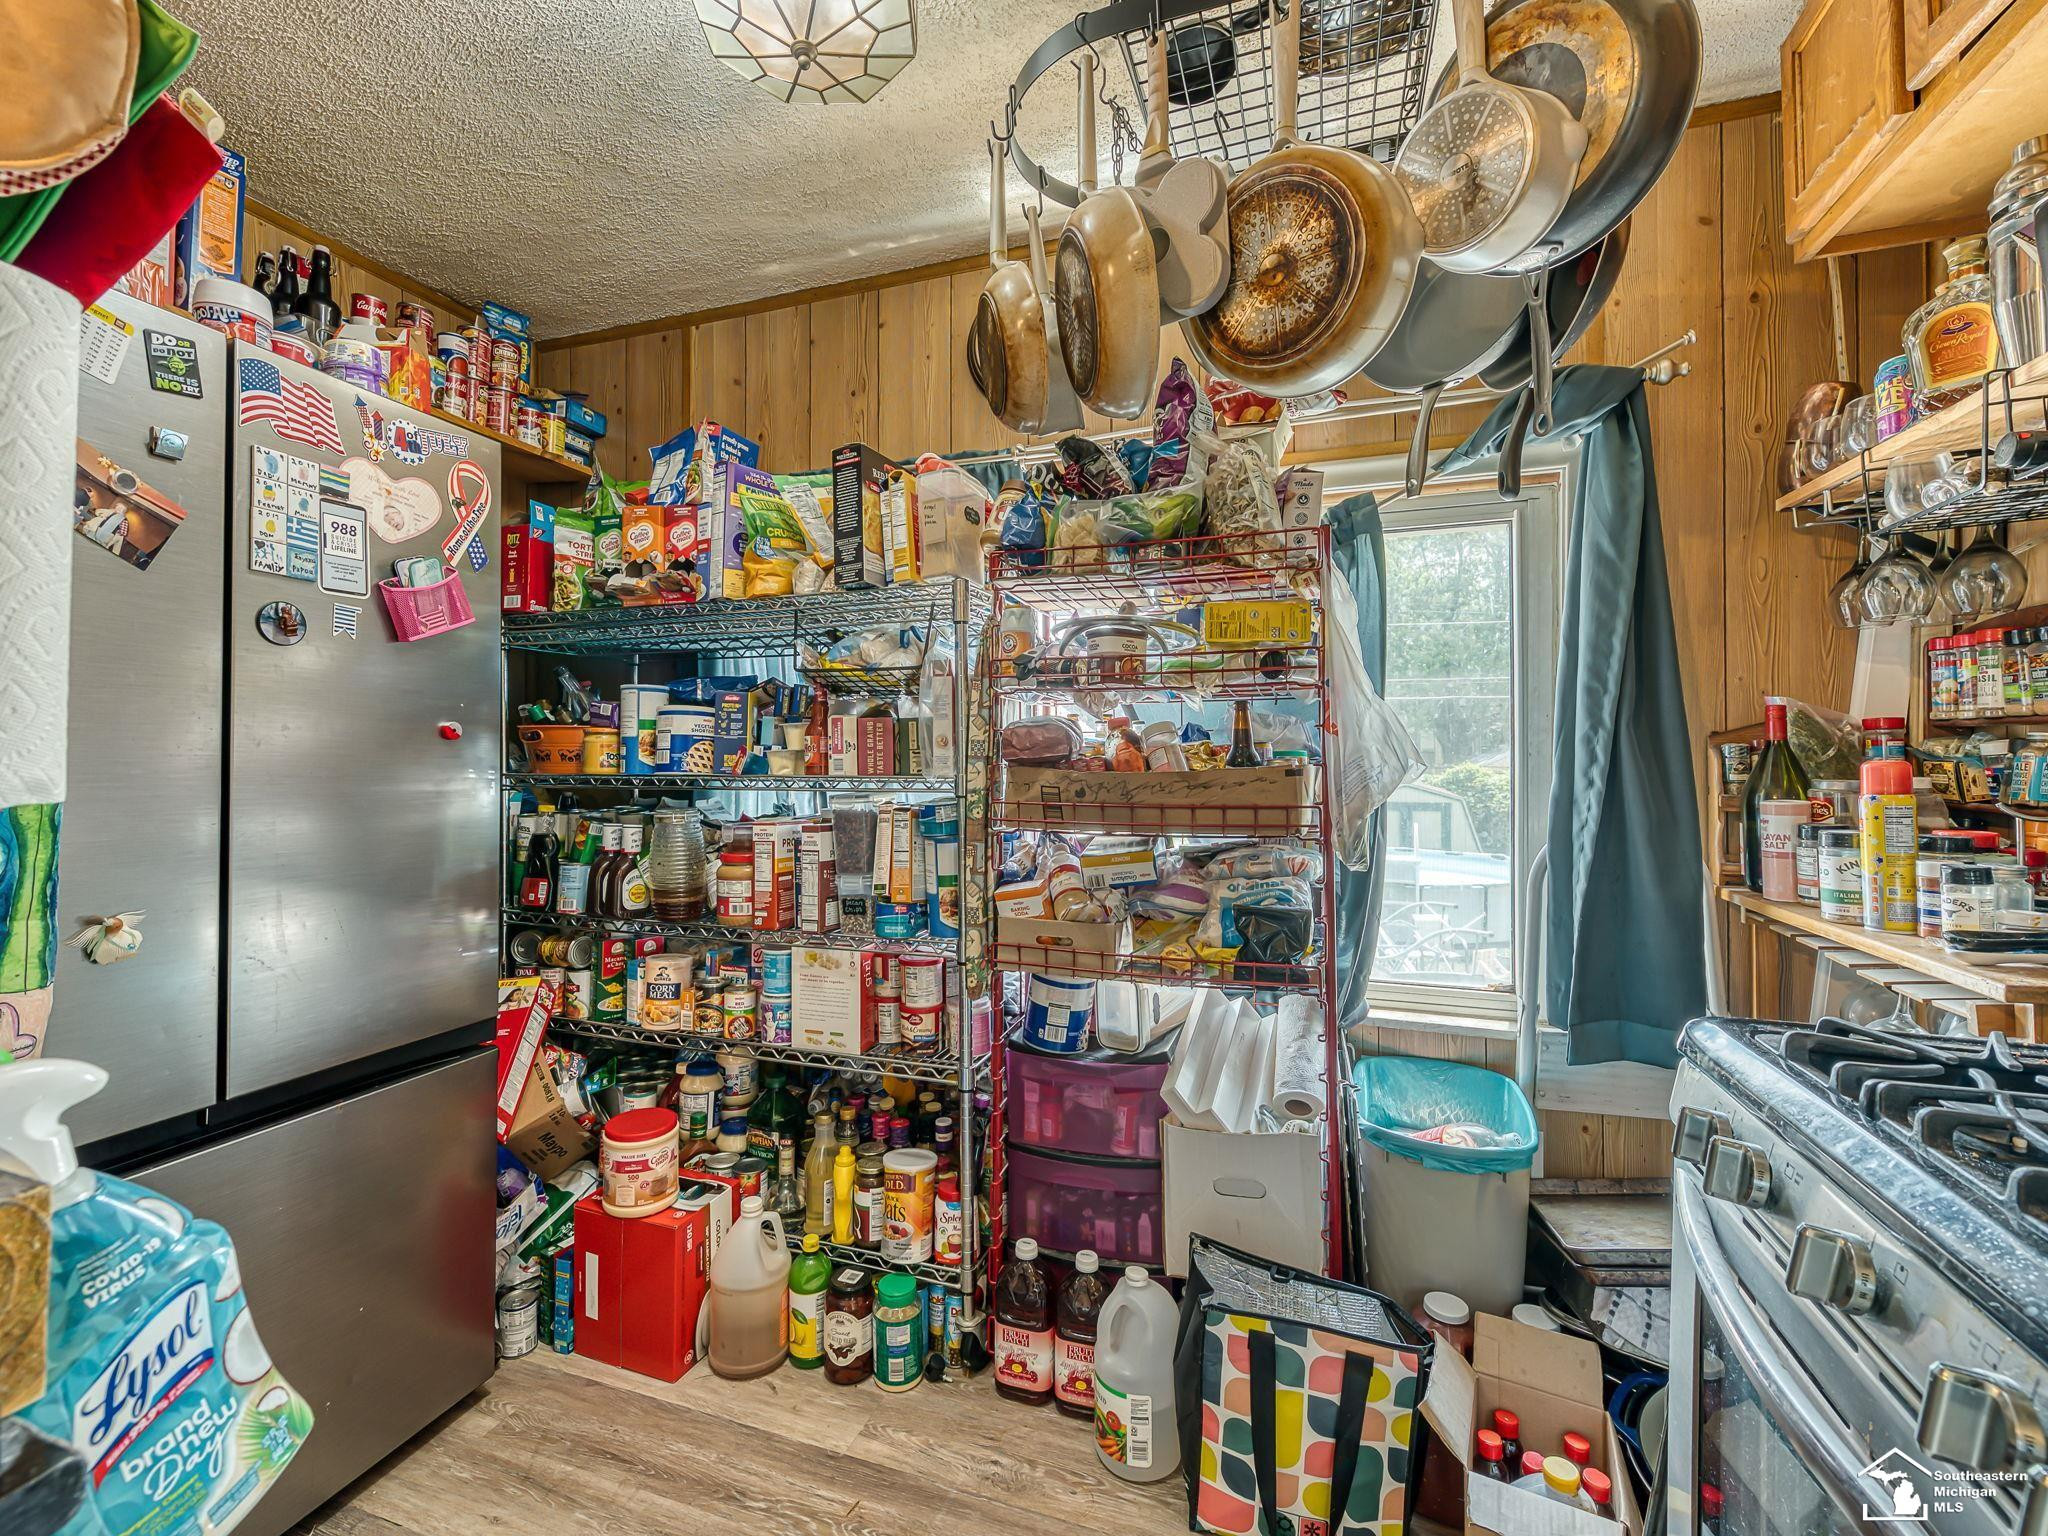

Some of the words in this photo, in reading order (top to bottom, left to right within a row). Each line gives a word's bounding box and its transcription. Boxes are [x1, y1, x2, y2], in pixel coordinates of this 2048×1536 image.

[151, 333, 176, 346] DO
[177, 340, 190, 348] OR
[1930, 337, 1955, 353] Crown
[1953, 327, 1986, 346] Royal
[156, 372, 185, 382] THERE
[186, 378, 199, 387] IS
[156, 377, 182, 391] NO
[183, 385, 200, 395] TRY
[407, 431, 418, 440] of
[418, 428, 469, 458] JULY
[331, 521, 357, 537] 988
[447, 534, 465, 557] Home
[473, 502, 486, 520] Free
[507, 533, 520, 547] RITZ
[568, 541, 594, 551] TORTI
[331, 544, 357, 555] LIFELINE
[876, 722, 884, 750] BETTER
[876, 751, 884, 774] TASTE
[1762, 834, 1791, 842] LAYAN
[1764, 842, 1788, 850] SALT
[1833, 891, 1860, 899] ITALIAN
[1010, 905, 1031, 913] BAKING
[649, 991, 675, 999] MEAL
[537, 1132, 568, 1158] Maypo
[82, 1237, 161, 1295] COVID-19
[83, 1264, 146, 1309] VIRUS
[1004, 1329, 1029, 1341] FRUIT
[1004, 1335, 1029, 1347] PATCH
[1068, 1352, 1095, 1364] PATCH
[1069, 1346, 1094, 1357] FRUIT
[81, 1290, 203, 1445] Lysol
[179, 1396, 237, 1457] new
[120, 1398, 211, 1483] brand
[143, 1418, 234, 1501] Day
